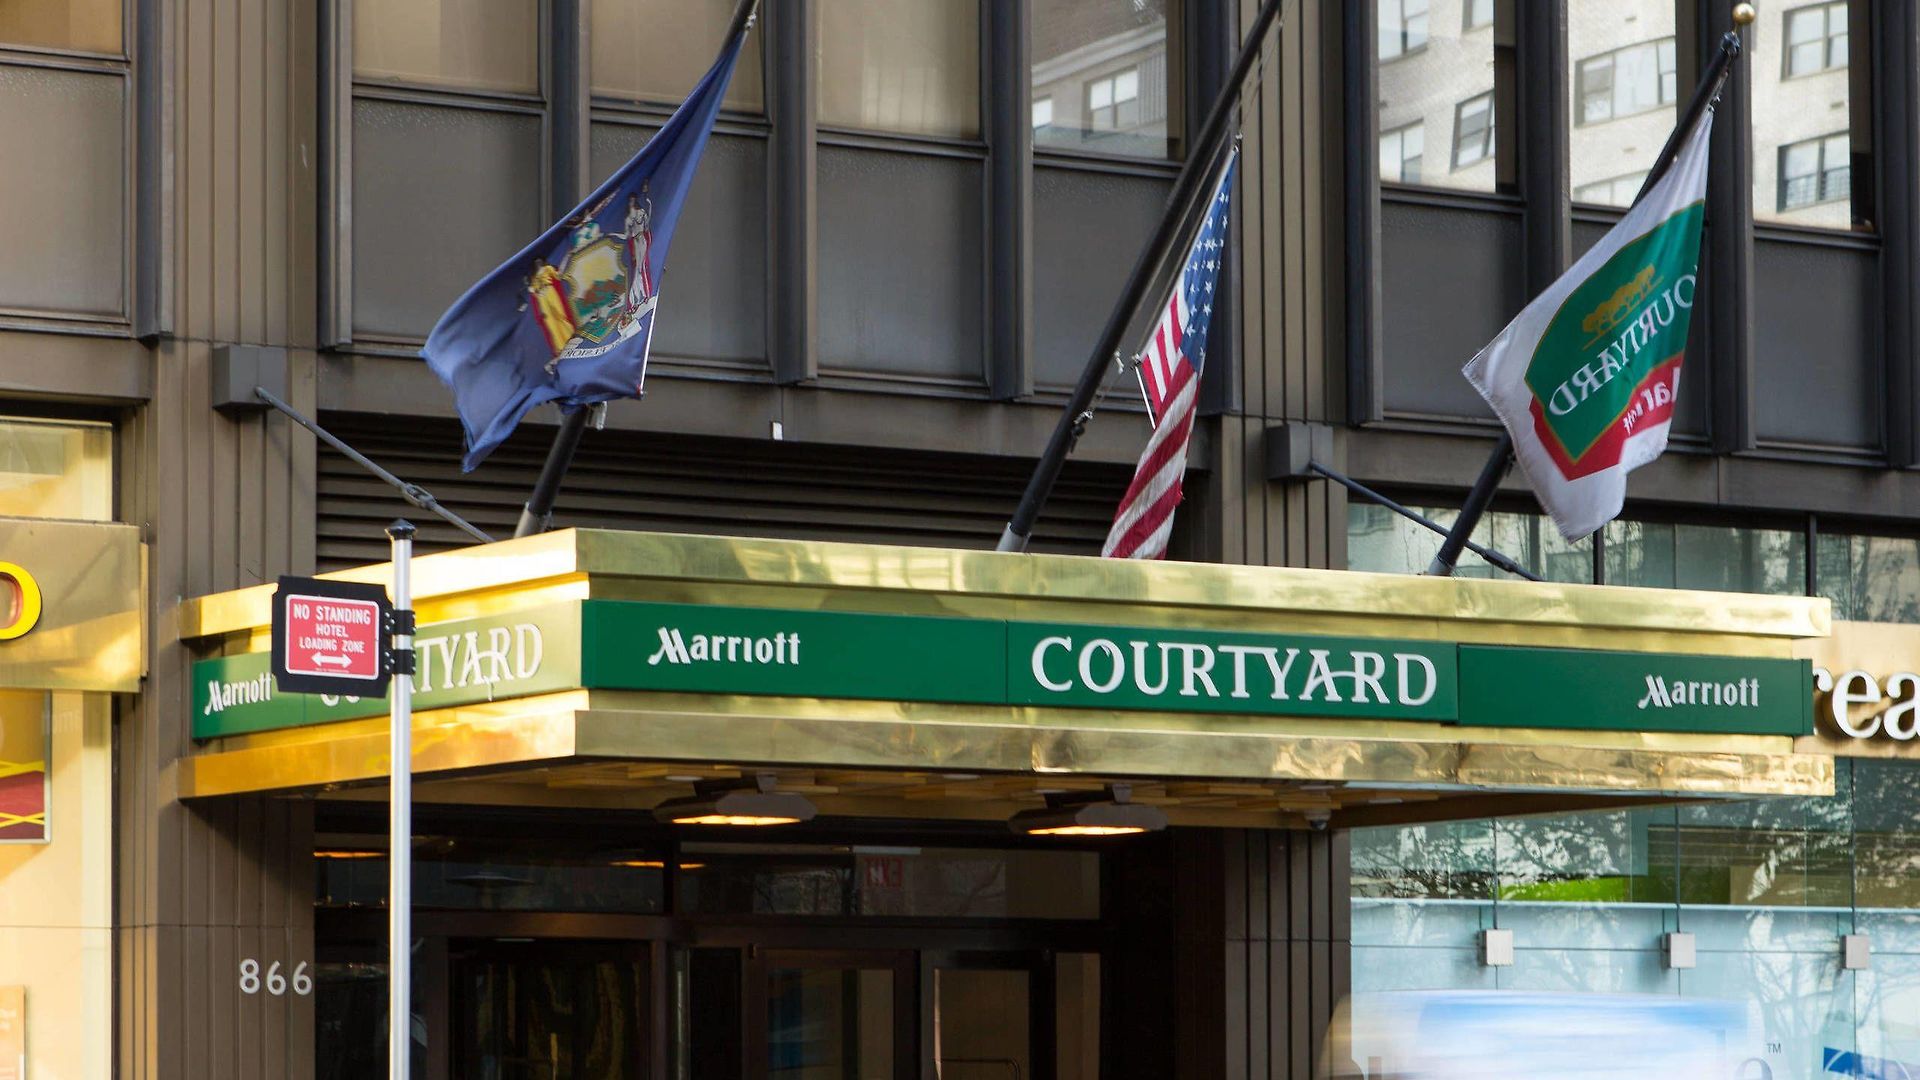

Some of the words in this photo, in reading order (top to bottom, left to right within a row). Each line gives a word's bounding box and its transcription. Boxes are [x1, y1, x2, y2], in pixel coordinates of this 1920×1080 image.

[293, 604, 310, 620] NO
[316, 605, 371, 625] STANDING
[315, 623, 349, 638] HOTEL
[299, 637, 338, 652] LOADING
[341, 640, 365, 654] ZONE
[647, 626, 801, 666] Marriott
[1031, 636, 1438, 707] COURTYARD
[204, 671, 272, 716] Marriott
[1637, 674, 1760, 710] Marriott
[240, 958, 313, 996] 866
